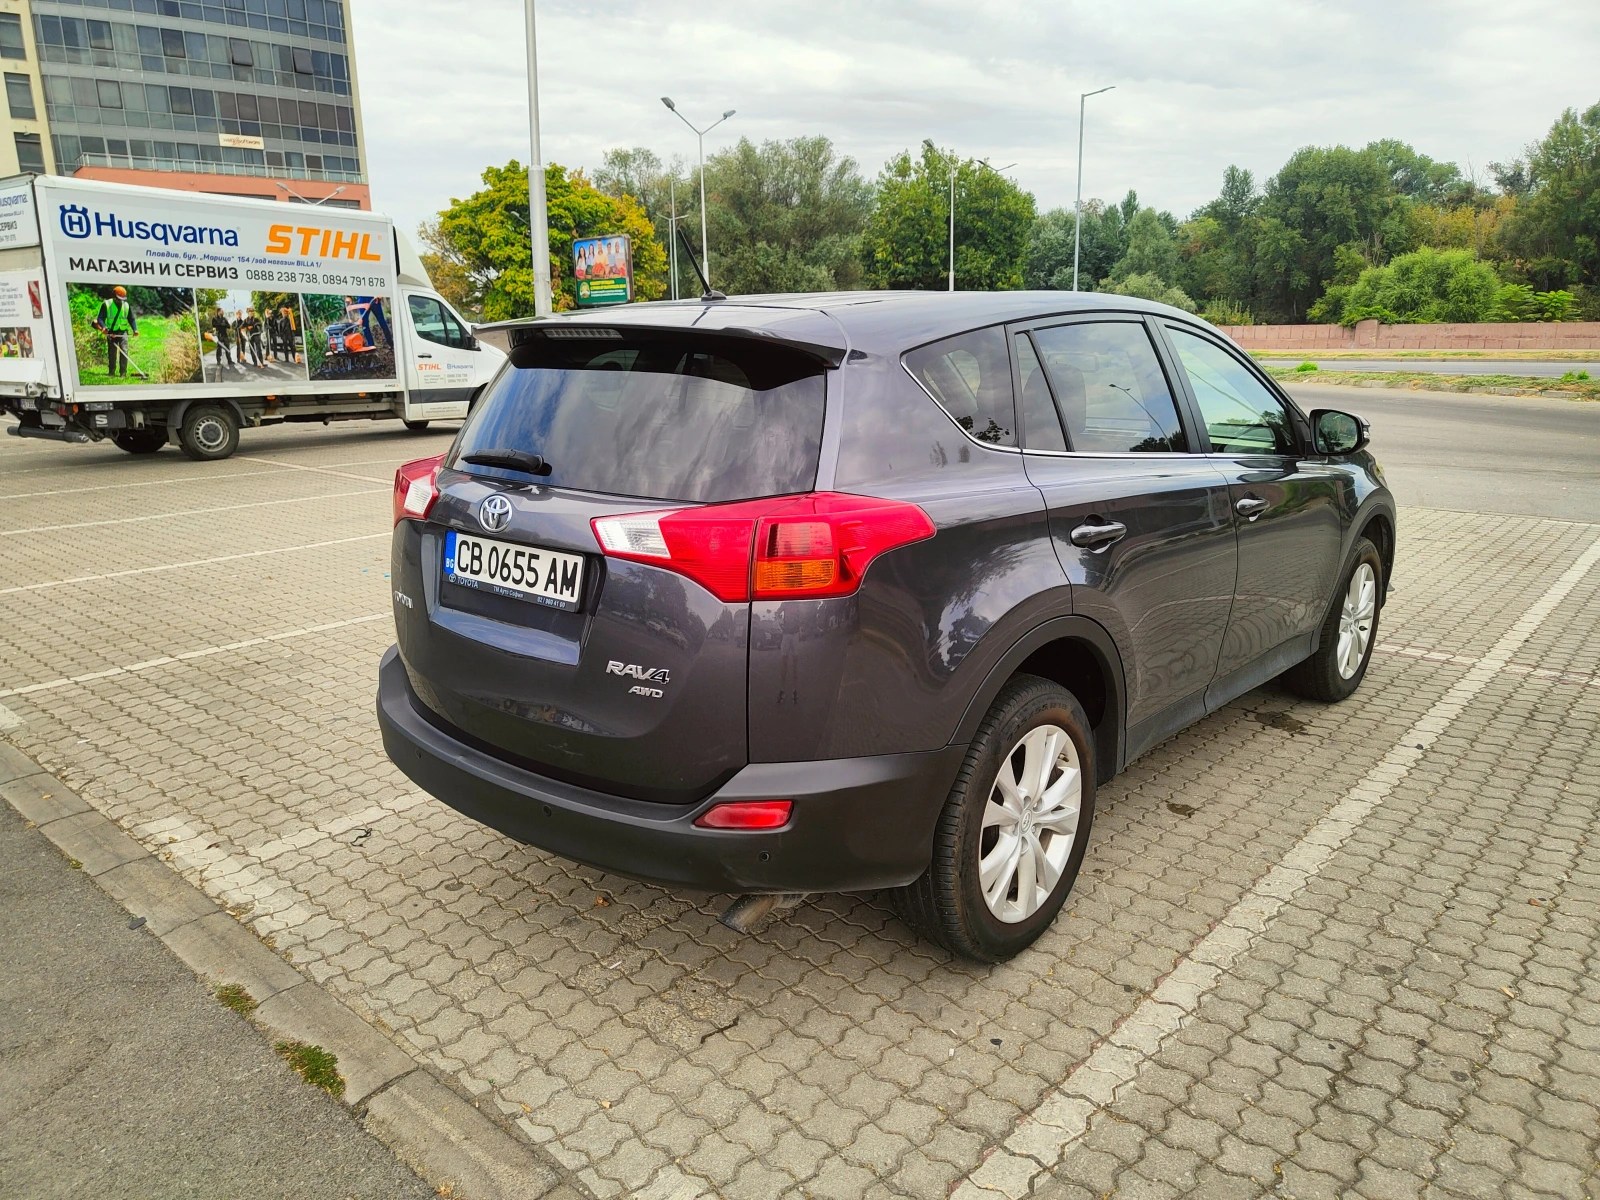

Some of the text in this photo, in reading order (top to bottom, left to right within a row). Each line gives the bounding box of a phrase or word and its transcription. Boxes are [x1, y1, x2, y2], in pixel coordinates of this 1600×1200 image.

[94, 211, 239, 247] Husqvarna
[265, 224, 382, 262] STIHL
[69, 256, 240, 281] МАГАЗИН И СЕРВИЗ
[145, 249, 181, 260] Пловдив,
[182, 251, 199, 262] бул.
[237, 256, 251, 264] 154
[267, 258, 296, 267] магазин
[296, 259, 315, 268] BILLA
[245, 268, 386, 288] 0888 238 738, 0894 791 878
[417, 363, 442, 371] STIHL
[445, 539, 579, 598] BG CB 0655 AM
[456, 576, 479, 589] TOYOTA
[605, 660, 671, 685] RAV4
[627, 685, 664, 699] AWD
